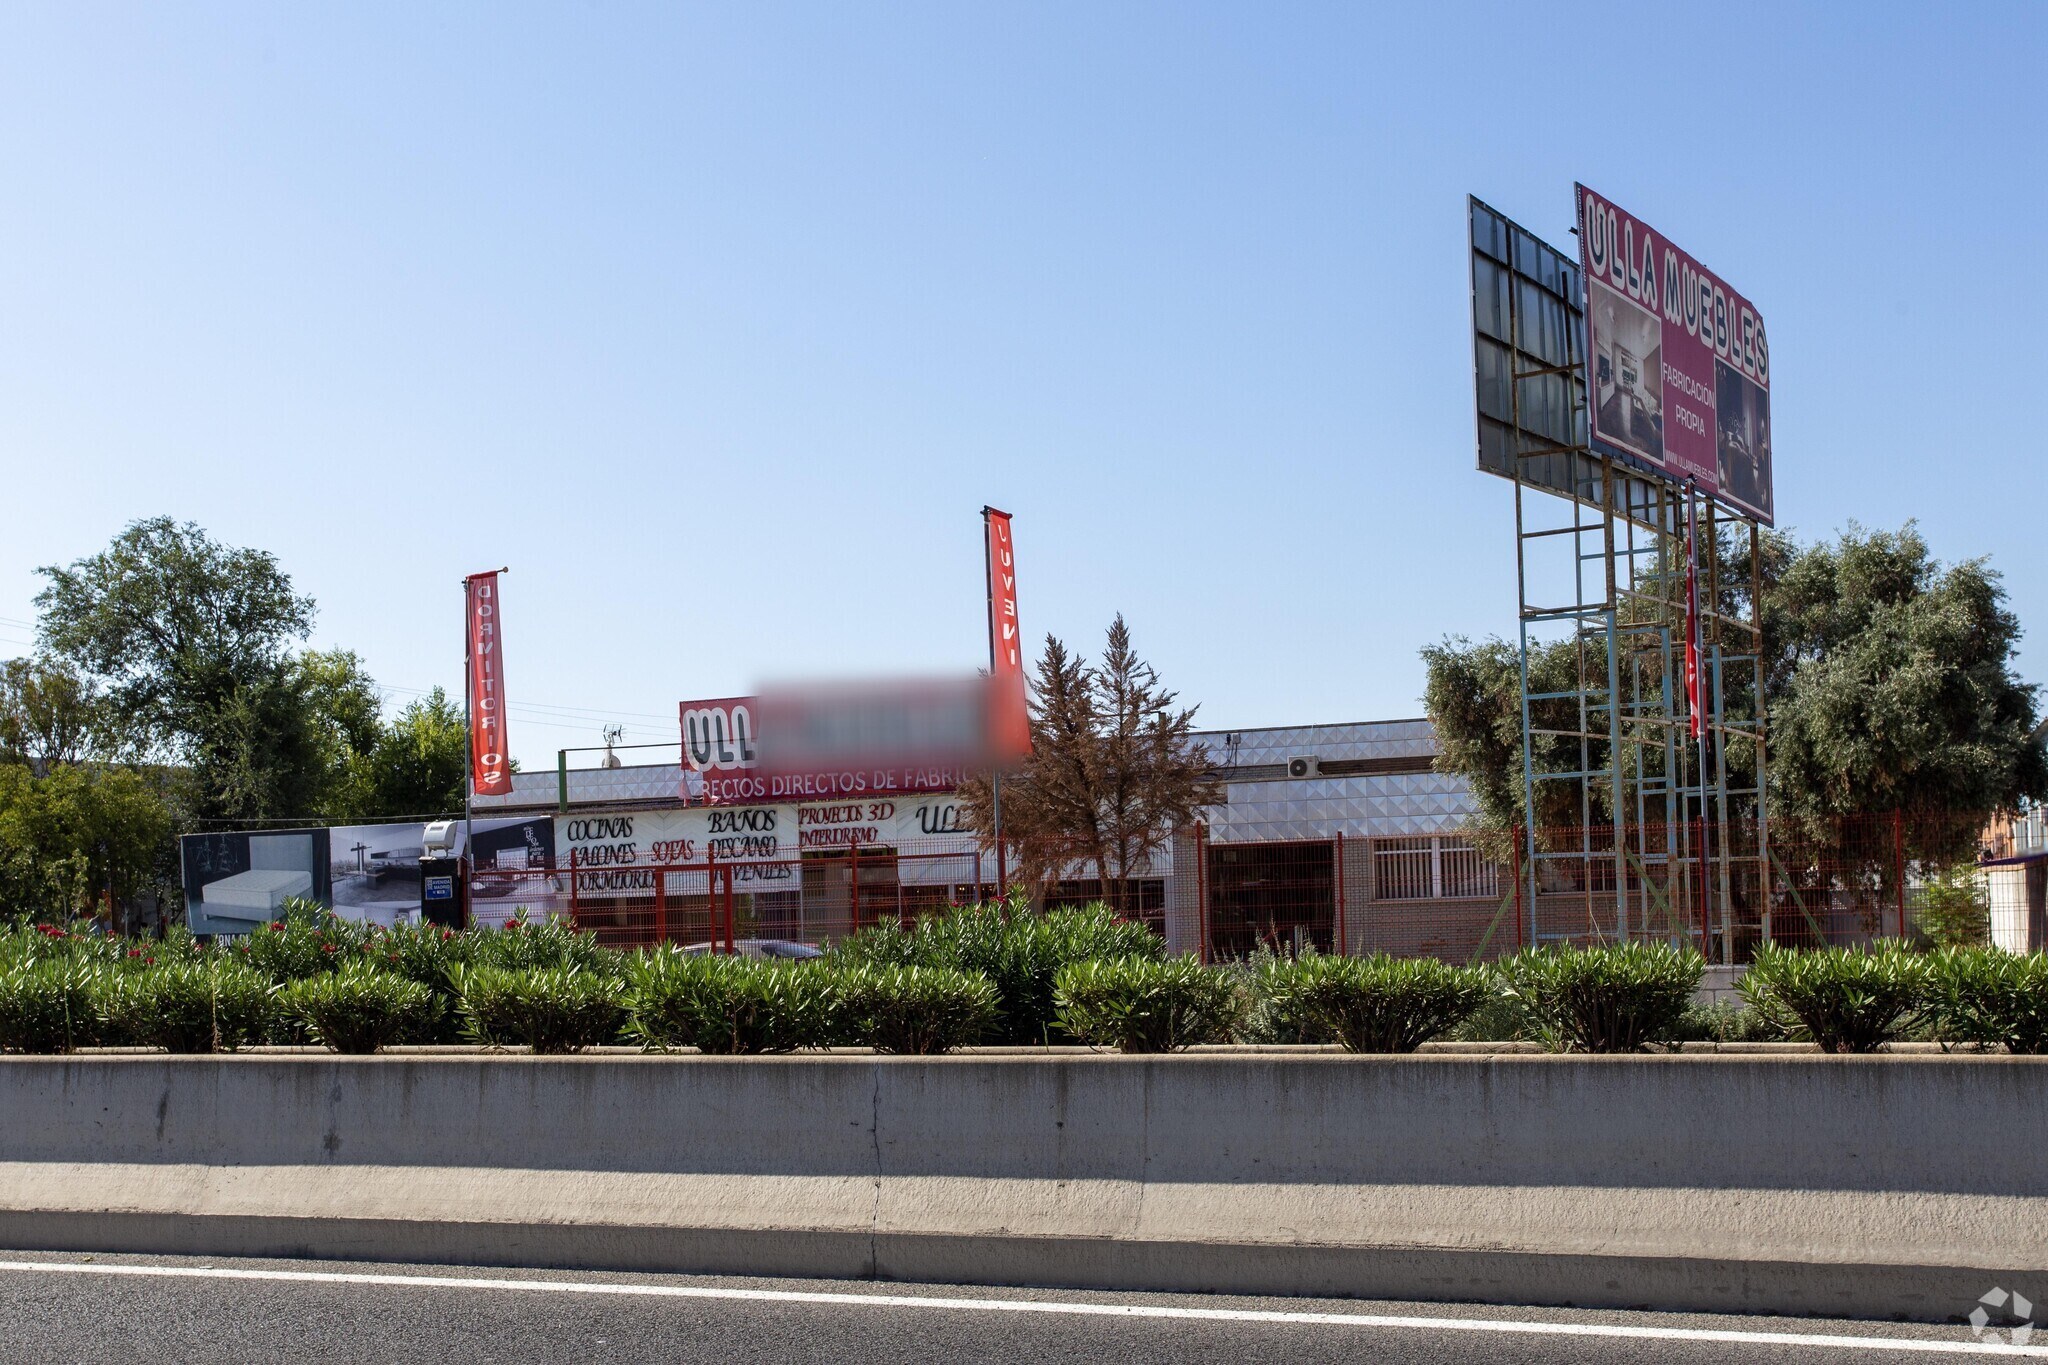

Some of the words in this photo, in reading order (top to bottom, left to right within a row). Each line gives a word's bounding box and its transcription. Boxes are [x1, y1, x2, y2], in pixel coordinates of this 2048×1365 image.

[1585, 193, 1658, 311] ULLA
[1662, 247, 1769, 384] MUEBLES
[1662, 361, 1715, 410] FABRICACIÓN
[1675, 407, 1706, 438] PROPIA
[683, 705, 759, 772] ULL
[702, 777, 765, 799] RECIOS
[771, 771, 866, 796] DIRECTOS
[873, 769, 897, 790] DE
[904, 766, 971, 788] FABRIC
[708, 809, 776, 833] BAÑOS
[798, 804, 863, 825] PROYECTOS
[867, 802, 895, 821] 3D
[915, 805, 974, 834] ULL
[567, 817, 633, 841] COCINAS
[575, 870, 657, 890] DORMITORIO
